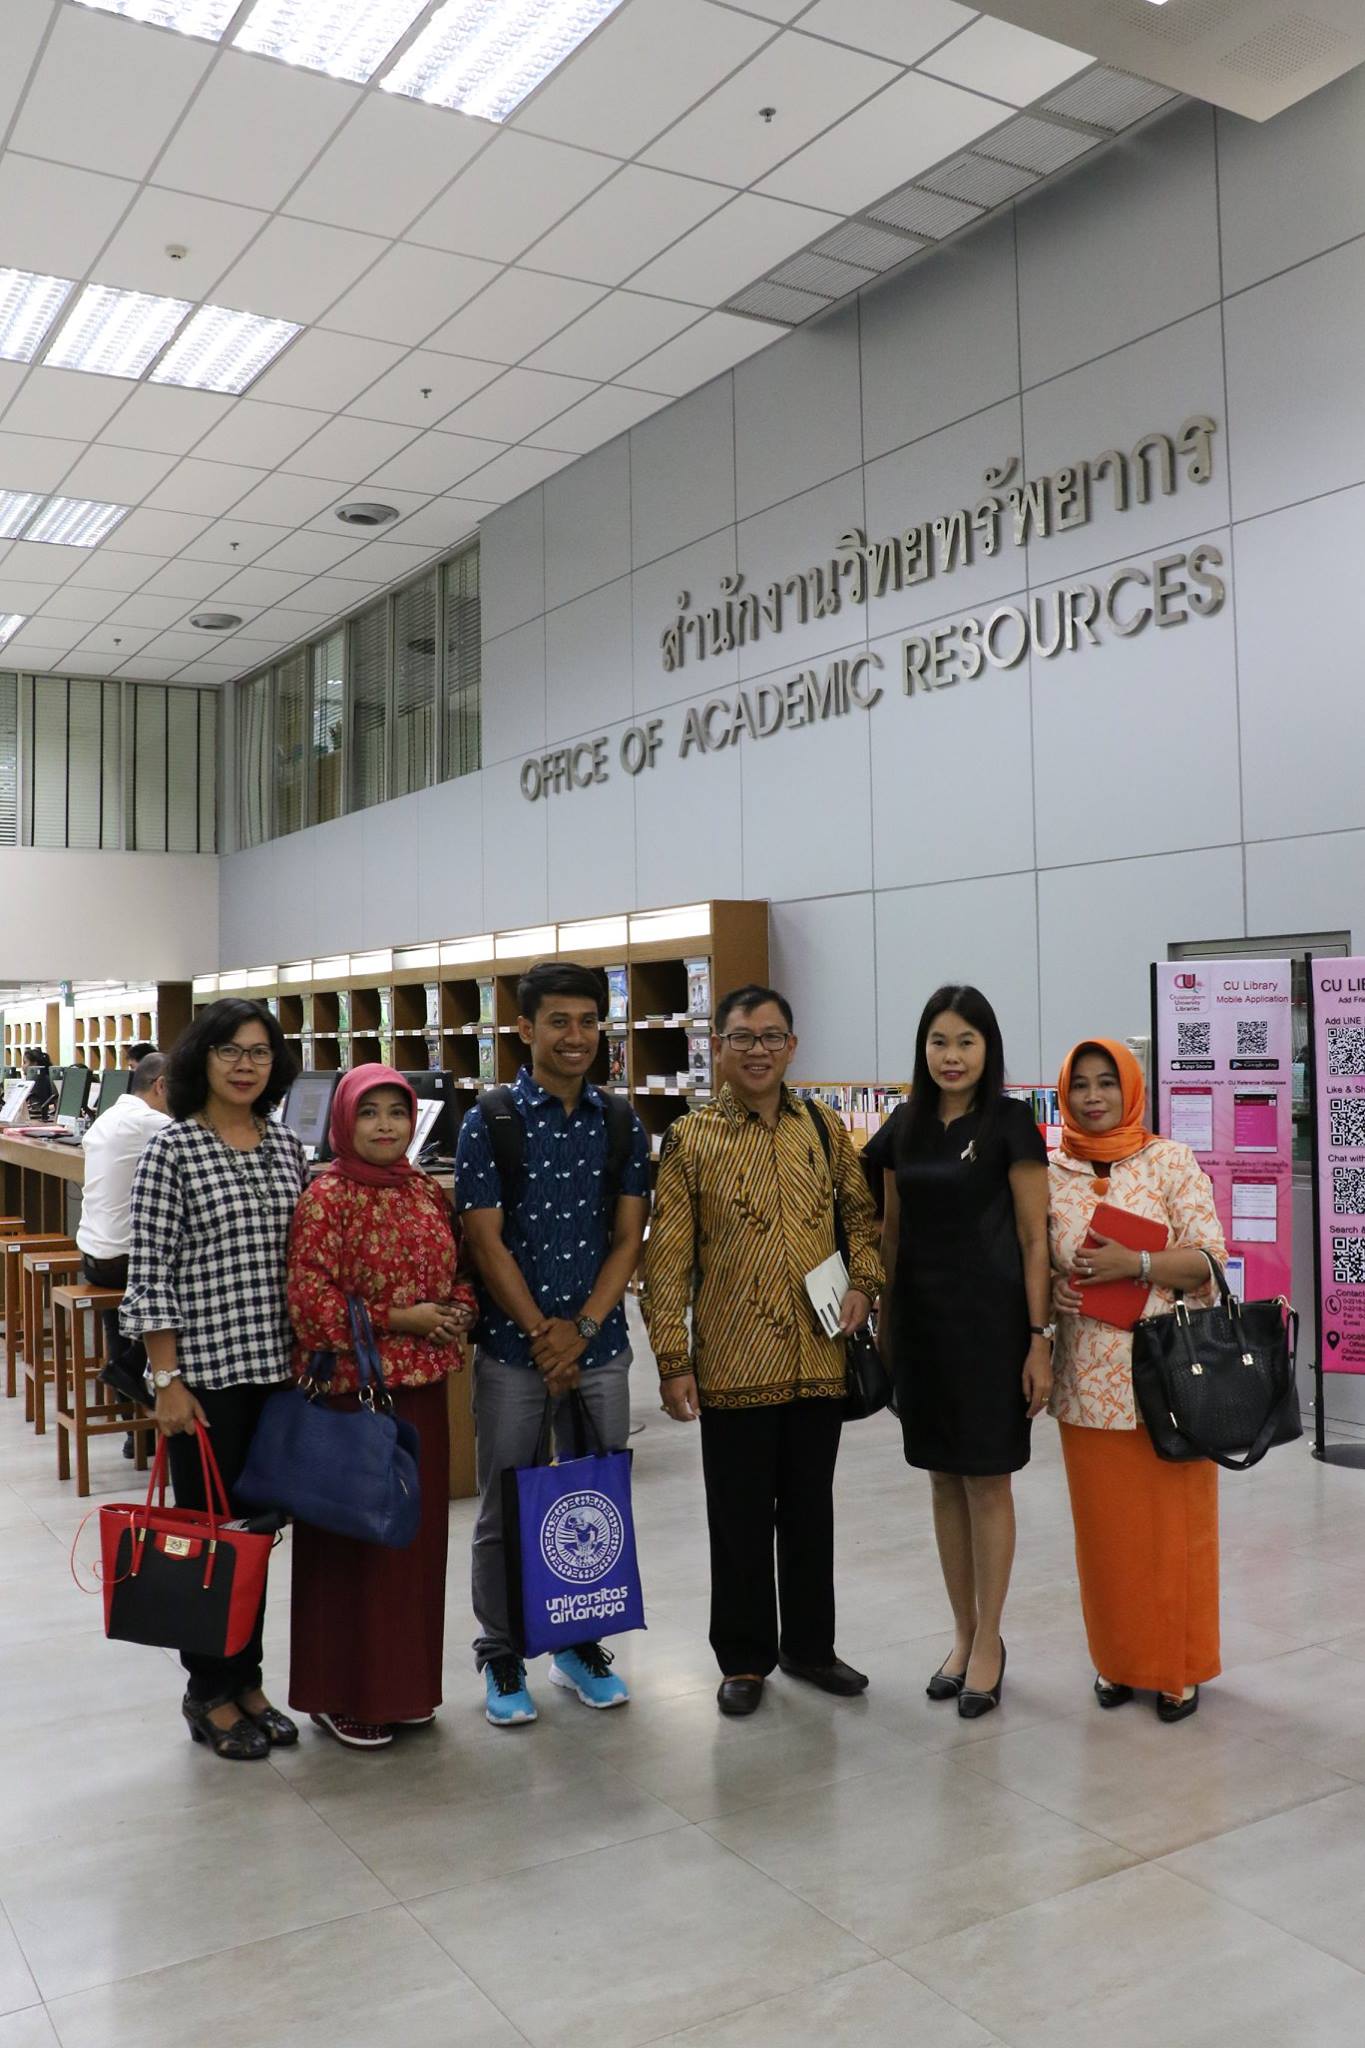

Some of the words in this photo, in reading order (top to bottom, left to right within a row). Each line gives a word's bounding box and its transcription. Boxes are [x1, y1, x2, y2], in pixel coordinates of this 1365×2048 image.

[660, 415, 1217, 672] สำนักงานวิทยทรัพยากร
[520, 737, 608, 801] OFFICE
[619, 718, 664, 776] OF
[678, 651, 884, 760] ACADEMIC
[902, 544, 1226, 697] RESOURCES
[1223, 981, 1240, 991] CU
[1243, 981, 1278, 992] Library
[1321, 979, 1342, 992] CU
[1216, 995, 1243, 1003] Mobile
[1244, 994, 1289, 1004] Application
[1325, 1017, 1341, 1025] Add
[1343, 1017, 1361, 1025] LINE
[1326, 1085, 1342, 1094] Like
[1345, 1085, 1352, 1093] &
[1328, 1154, 1347, 1162] Chat
[1329, 1225, 1359, 1233] Search
[546, 1586, 628, 1610] universitas
[551, 1601, 625, 1624] airlangga
